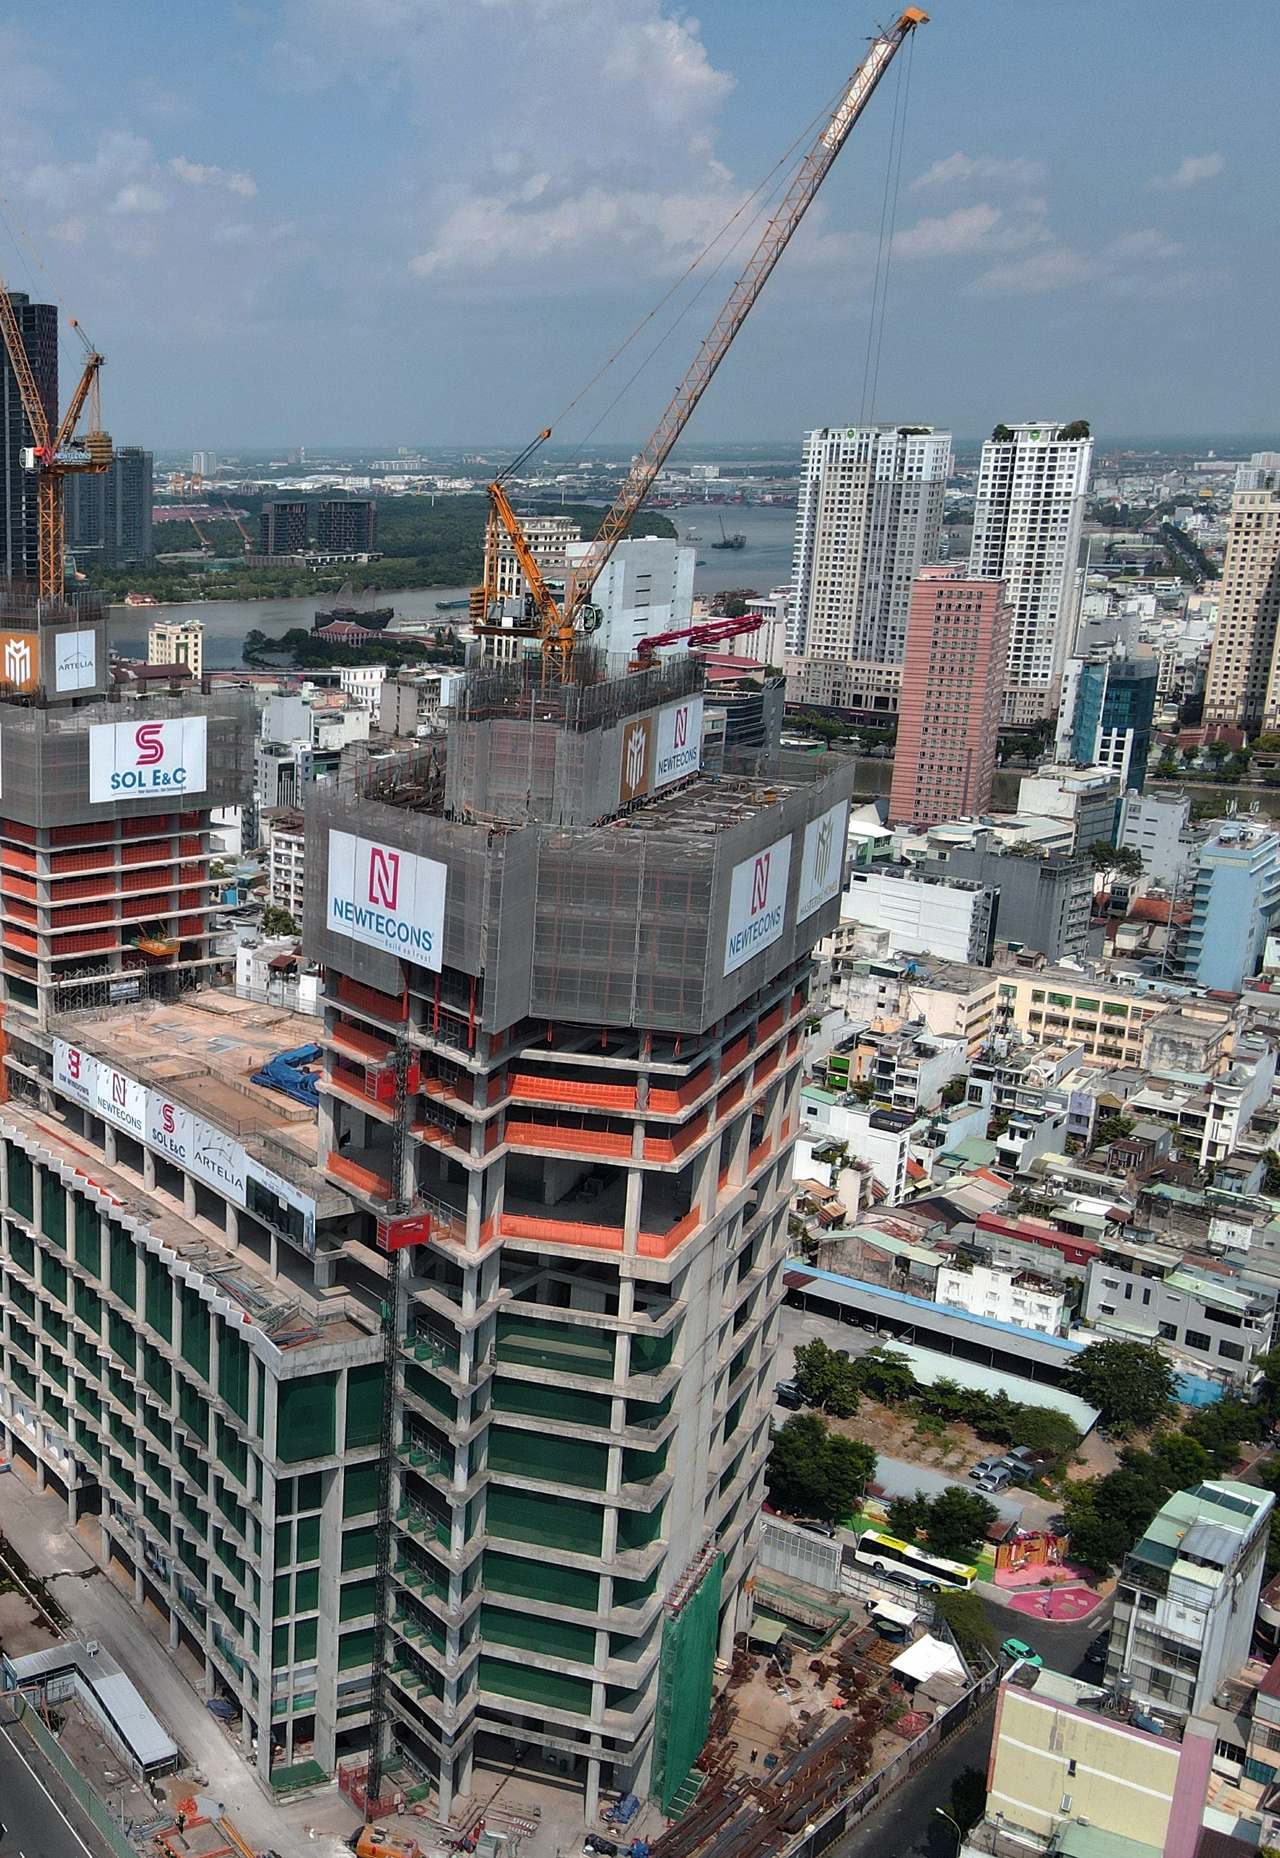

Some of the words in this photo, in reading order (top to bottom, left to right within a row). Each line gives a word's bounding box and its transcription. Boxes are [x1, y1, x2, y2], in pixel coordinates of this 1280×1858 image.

[58, 660, 94, 671] ARTELIA
[658, 746, 698, 775] NEWTECONS
[110, 770, 147, 790] SOL
[152, 767, 187, 787] E&C
[333, 897, 433, 952] NEWTECONS
[728, 905, 782, 958] NEWTECONS
[67, 1078, 90, 1096] WINDOWS
[97, 1095, 142, 1131] NEWTECONS
[152, 1128, 168, 1149] SOL
[169, 1139, 186, 1158] E&C
[194, 1151, 244, 1192] ARTELIA
